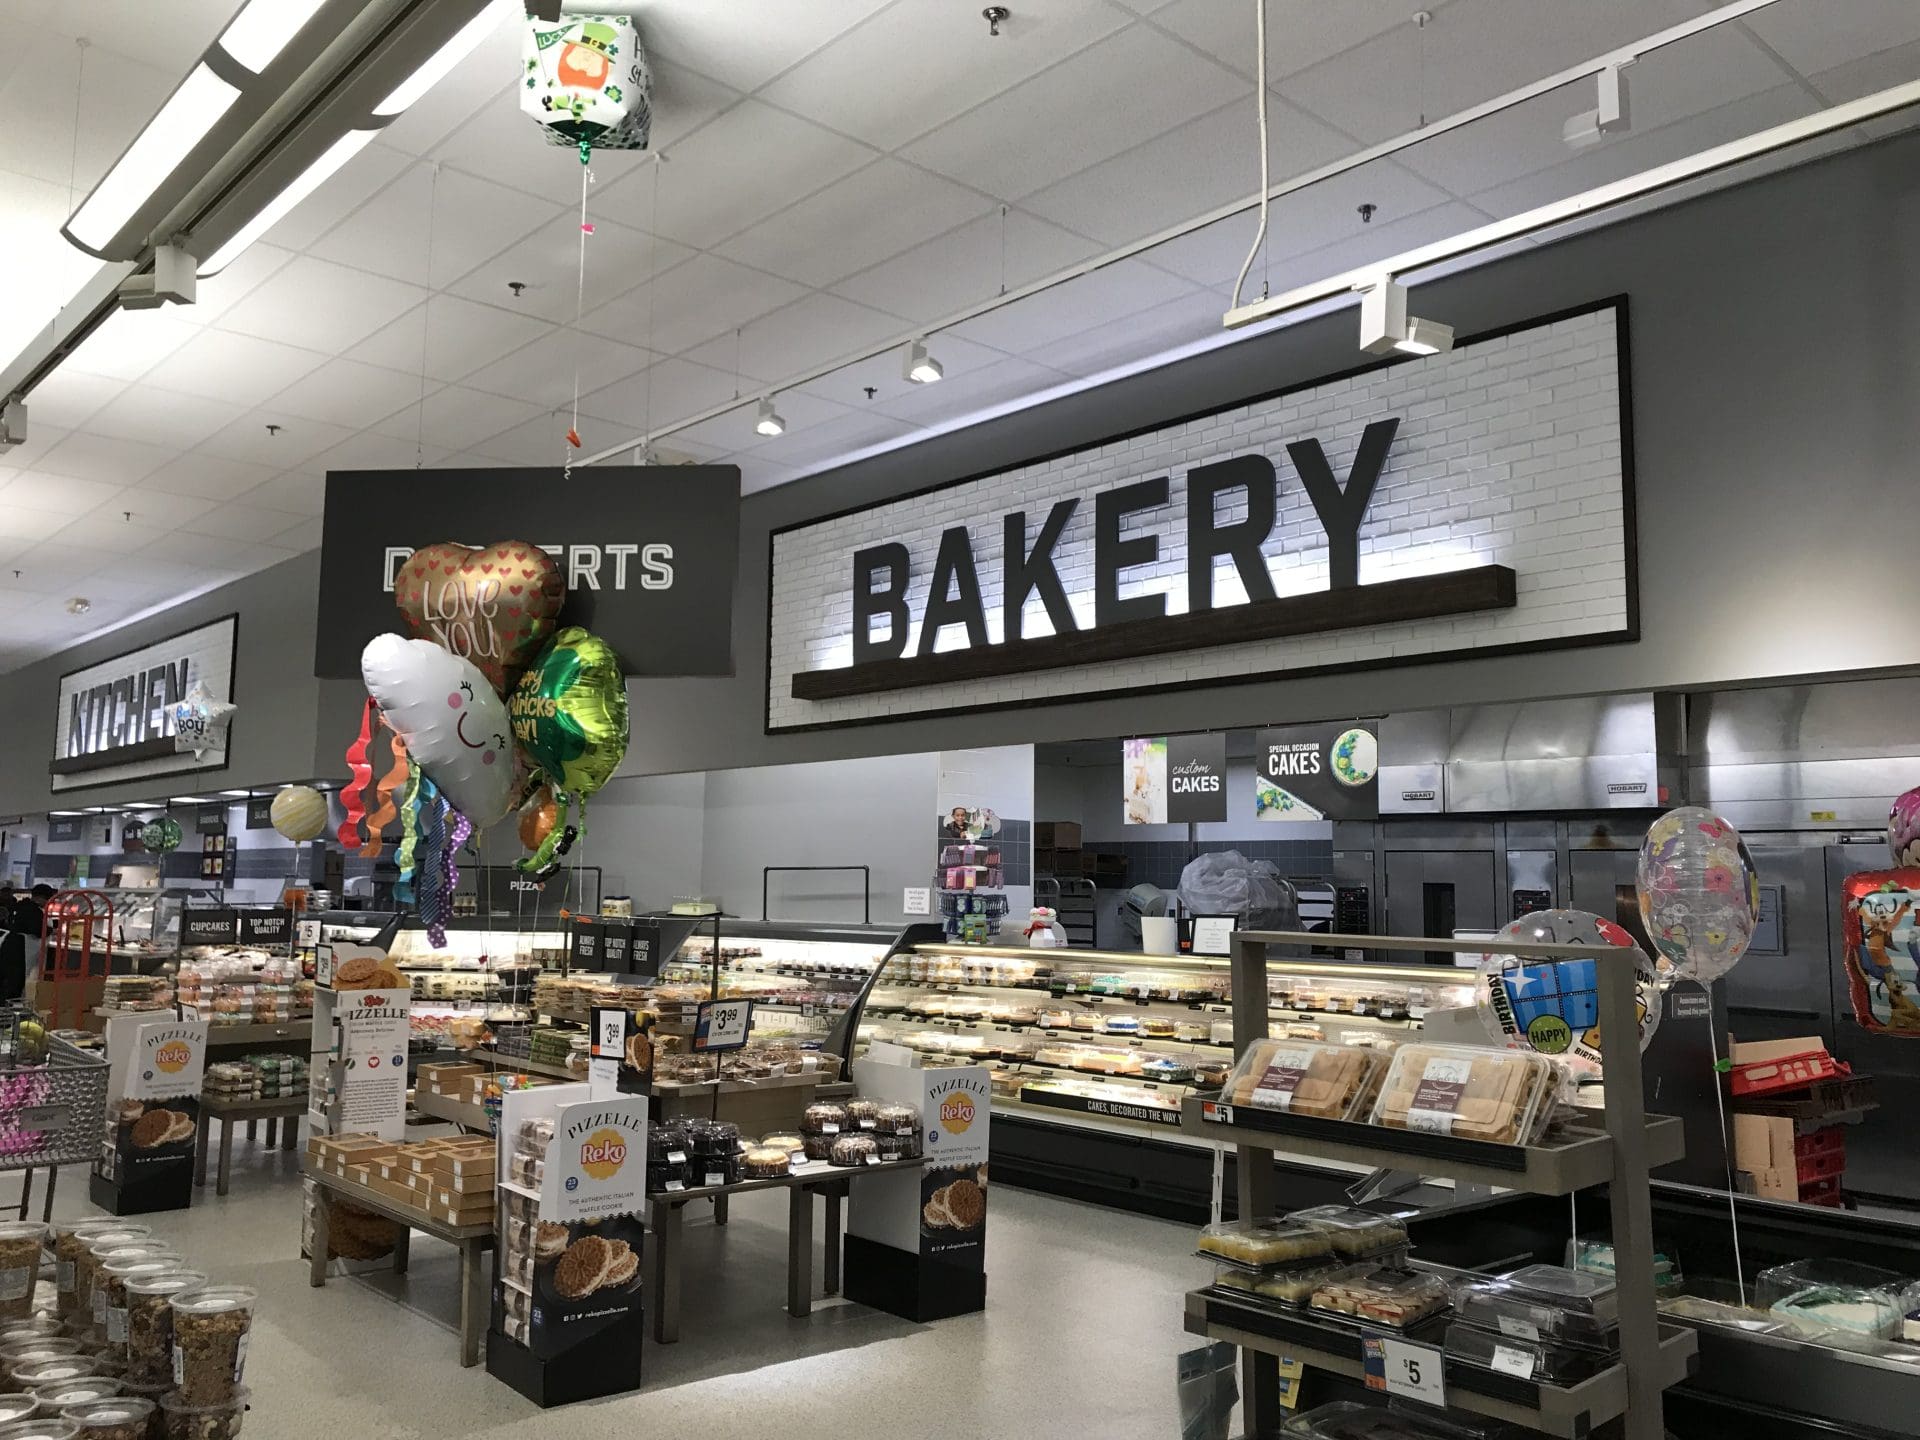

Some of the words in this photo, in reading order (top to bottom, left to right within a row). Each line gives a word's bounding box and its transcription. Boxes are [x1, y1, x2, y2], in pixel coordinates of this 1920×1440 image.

[538, 25, 572, 49] LUCKY
[852, 417, 1400, 663] BAKERY
[383, 543, 674, 592] DRTS
[431, 620, 499, 658] YOU
[67, 656, 189, 757] KITCHEN
[175, 703, 207, 722] Baby
[1268, 745, 1292, 753] SPECIAL
[1292, 743, 1320, 752] OCCASION
[1172, 758, 1211, 775] custom
[1268, 751, 1321, 776] CAKES
[1172, 775, 1220, 793] CAKES
[1609, 784, 1646, 793] HOBART
[510, 881, 539, 891] PIZZA
[190, 921, 230, 931] CUPCAKES
[250, 918, 263, 927] TOP
[264, 918, 285, 926] NOTCH
[254, 926, 280, 935] QUALITY
[1487, 973, 1517, 1035] BIRTHDAY
[349, 1008, 408, 1020] IZZELLE
[147, 1029, 203, 1048] PIZZELLE
[1531, 1027, 1567, 1044] HAPPY
[155, 1049, 192, 1064] Reko
[929, 1078, 988, 1100] PIZZELLE
[940, 1101, 976, 1122] Reko
[1087, 1100, 1110, 1114] CAKES,
[1110, 1103, 1148, 1119] DECORATED
[1148, 1109, 1161, 1121] THE
[1162, 1111, 1177, 1123] WAY
[567, 1112, 642, 1140] PIZZELLE
[581, 1139, 627, 1165] Reko
[568, 1198, 580, 1206] THE
[581, 1194, 612, 1204] AUTHENTIC
[613, 1191, 634, 1199] ITALIAN
[579, 1205, 601, 1213] WAFFLE
[1402, 1358, 1422, 1385] $5
